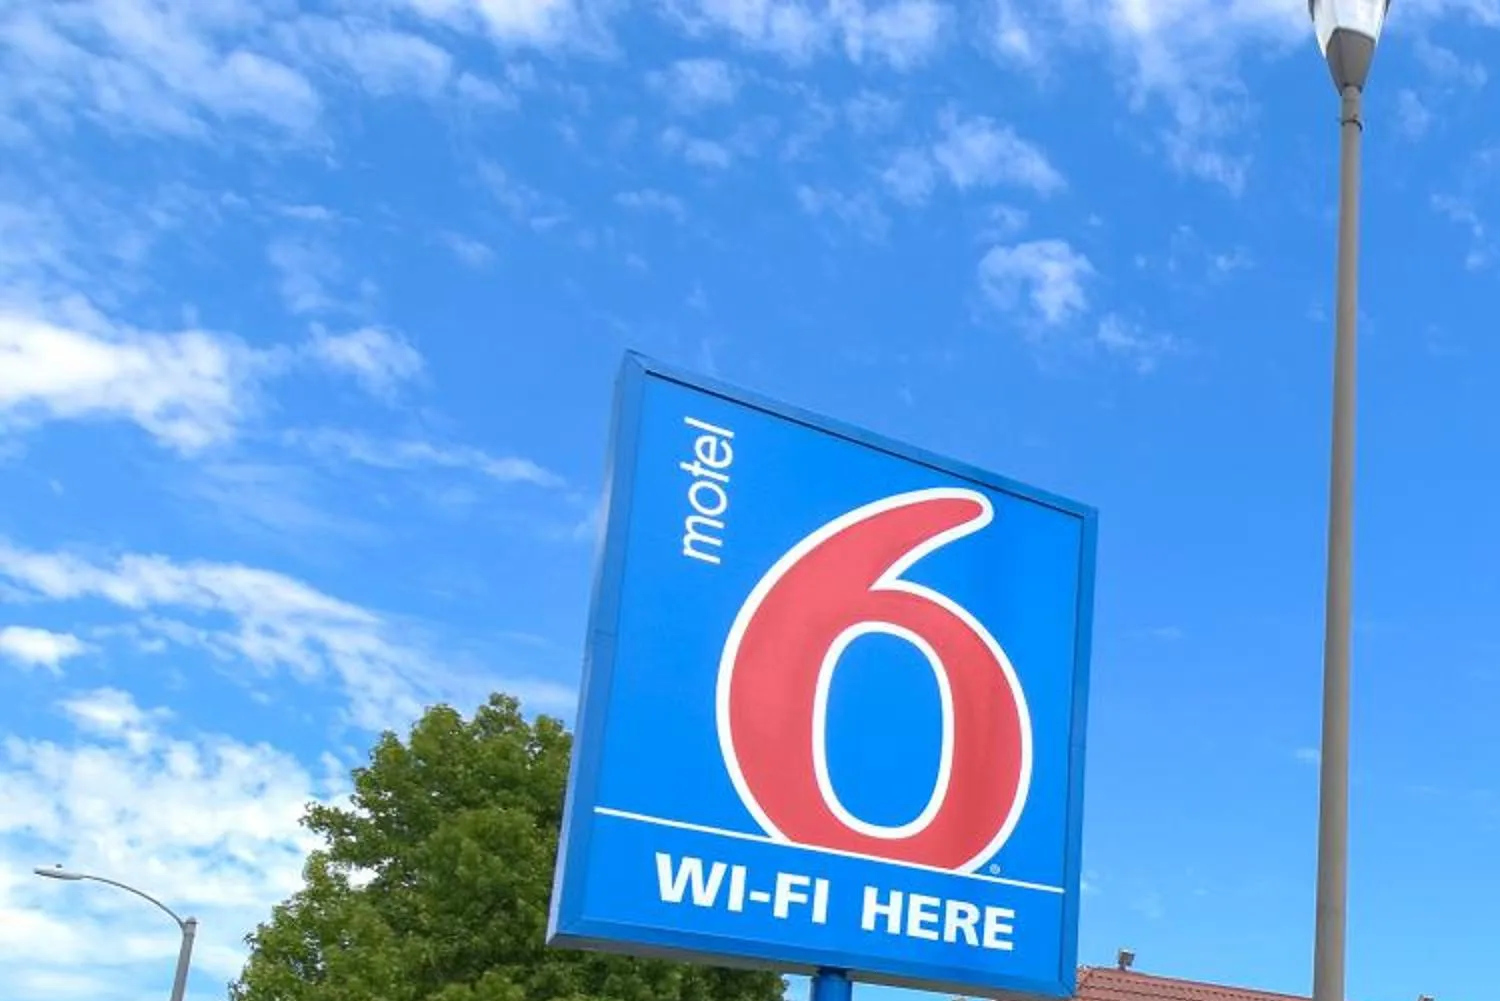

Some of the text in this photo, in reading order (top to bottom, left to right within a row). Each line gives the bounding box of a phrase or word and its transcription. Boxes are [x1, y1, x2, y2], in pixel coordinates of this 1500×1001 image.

[680, 416, 735, 565] motel
[715, 487, 1033, 874] 6
[655, 851, 1017, 951] WI-FI HERE
